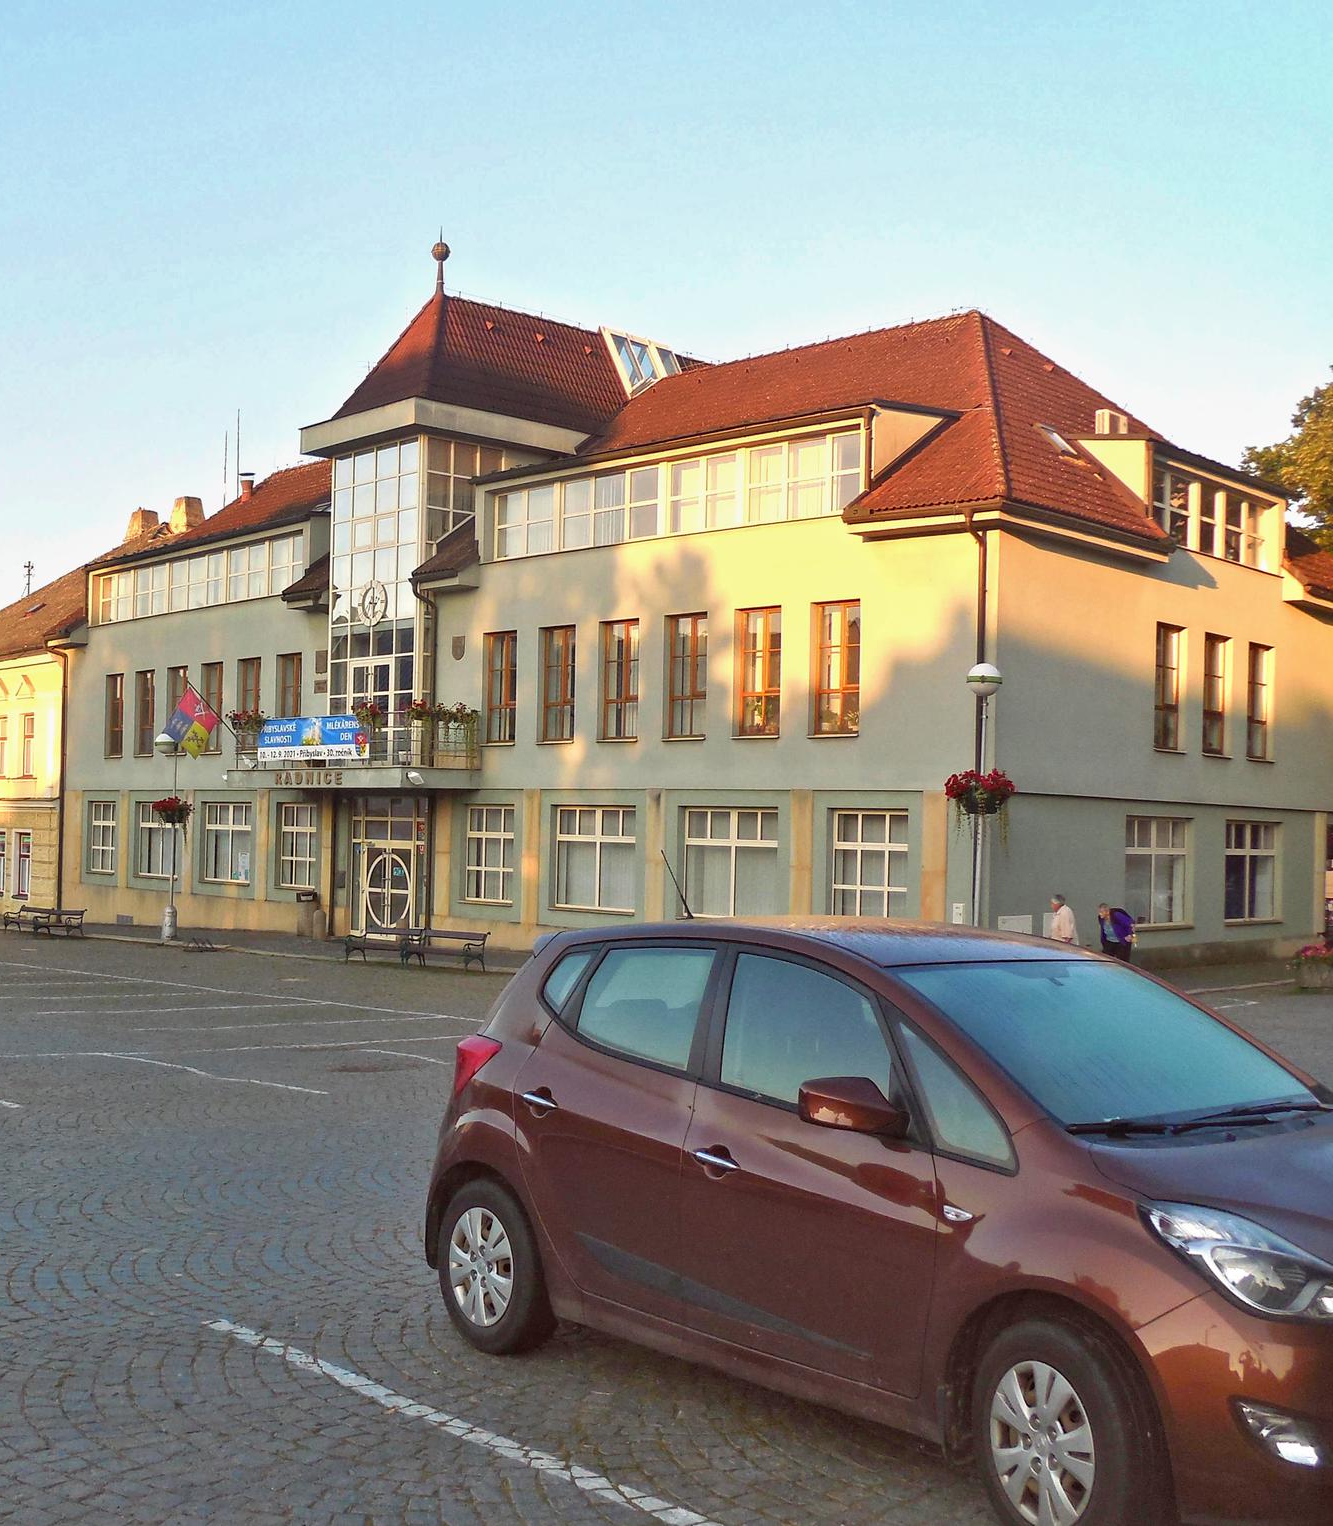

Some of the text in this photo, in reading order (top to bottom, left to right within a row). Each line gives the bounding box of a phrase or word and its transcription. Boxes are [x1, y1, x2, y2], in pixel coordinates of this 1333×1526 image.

[264, 735, 293, 744] SLAVNOSTI
[340, 732, 353, 741] DEN
[275, 771, 343, 786] RADNICE
